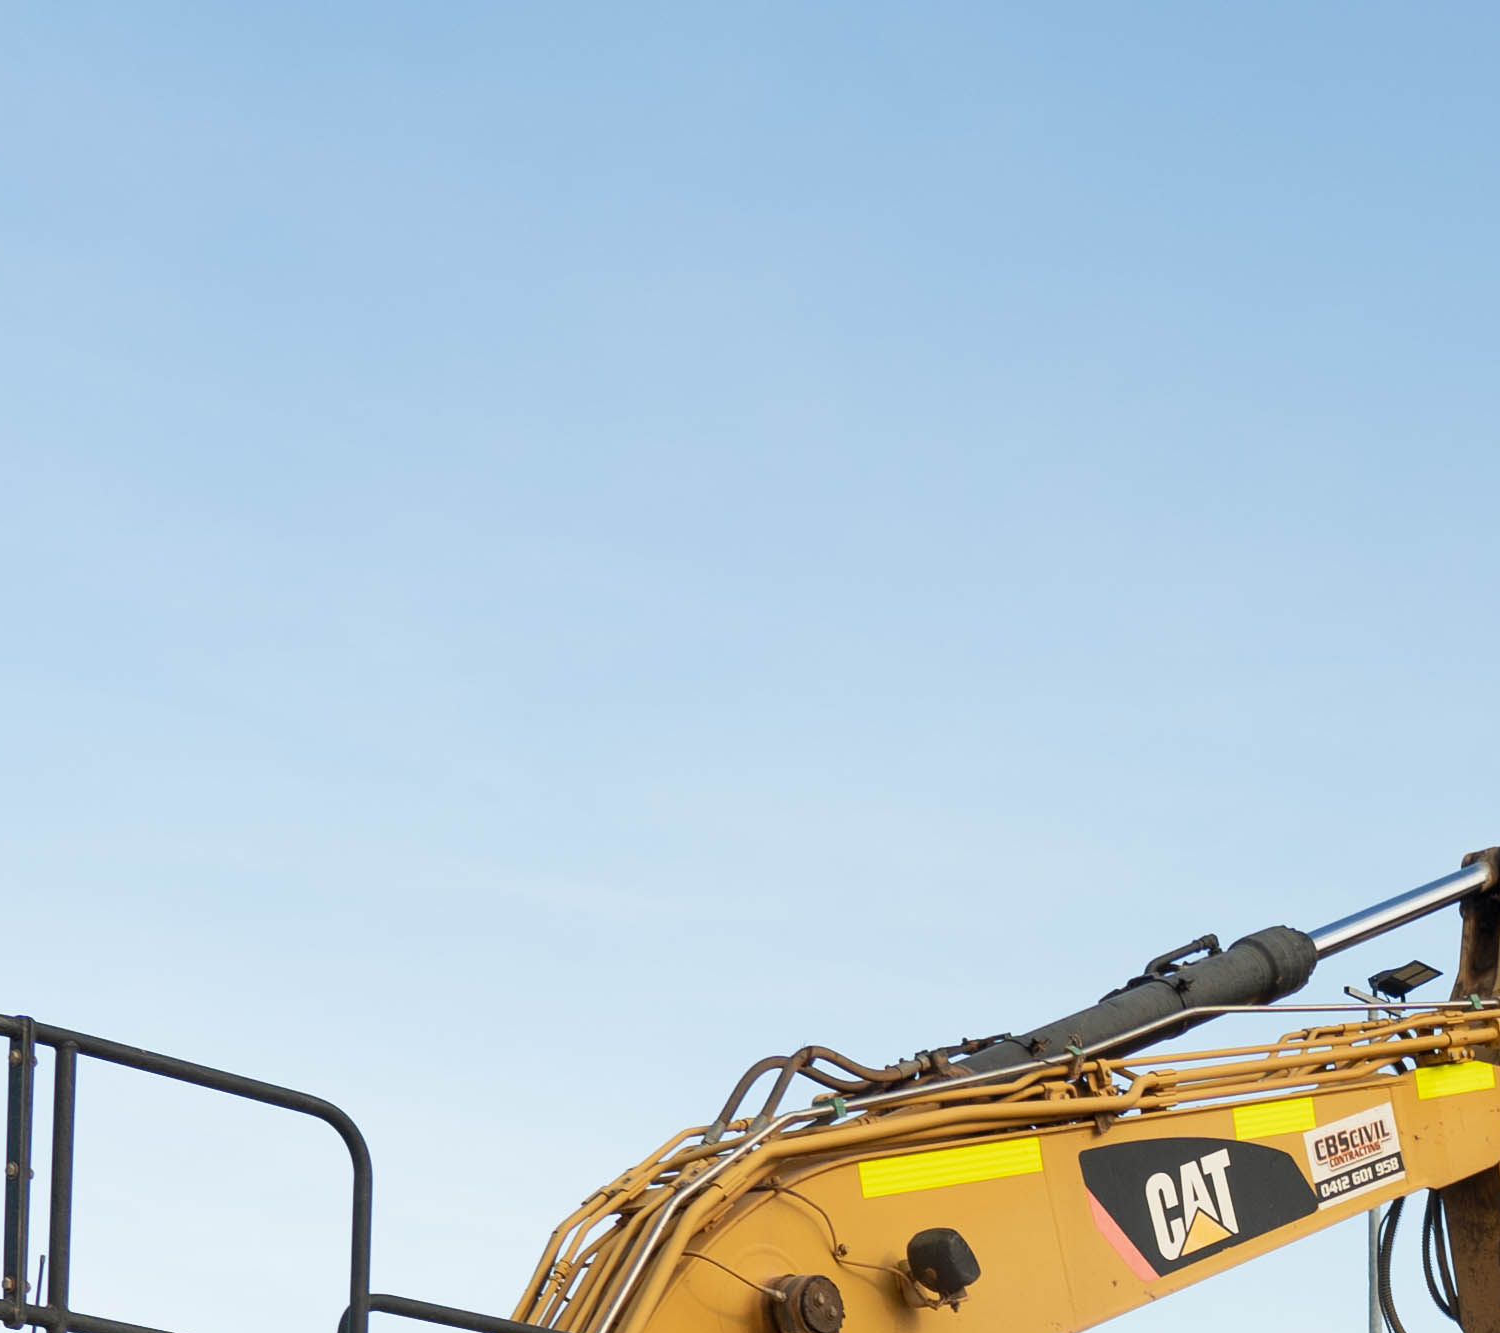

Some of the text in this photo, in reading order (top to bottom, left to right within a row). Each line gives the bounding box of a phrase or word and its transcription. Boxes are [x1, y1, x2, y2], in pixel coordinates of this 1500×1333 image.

[1329, 1141, 1381, 1168] CONTRACTING
[1320, 1157, 1400, 1198] 0412 601 958
[1145, 1148, 1240, 1261] CAT
